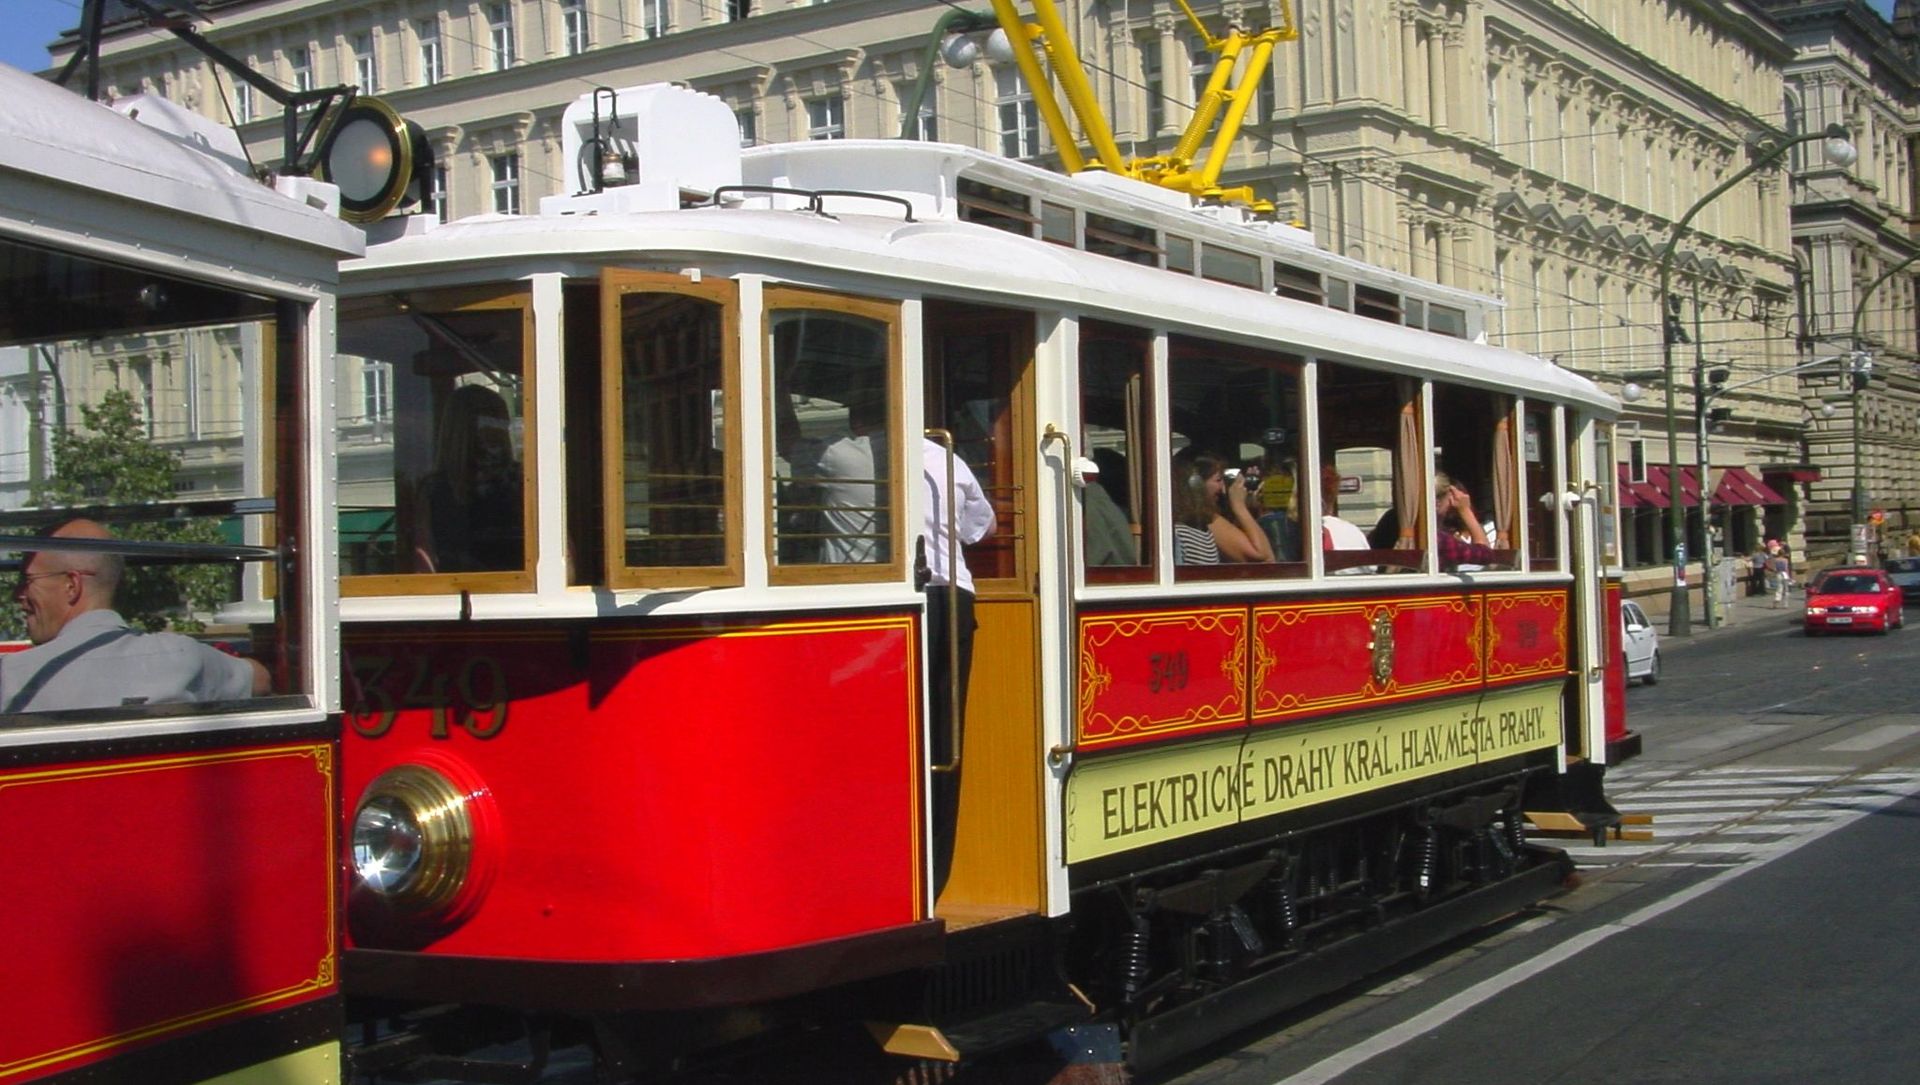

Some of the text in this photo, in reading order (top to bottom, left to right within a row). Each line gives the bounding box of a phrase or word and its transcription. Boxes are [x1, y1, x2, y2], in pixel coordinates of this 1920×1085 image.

[350, 655, 508, 739] 349
[1149, 652, 1188, 694] 349
[1102, 750, 1256, 840] ELEKTRICKÉ
[1264, 738, 1337, 803] DRÁHY
[1500, 706, 1545, 748] PRAHY.
